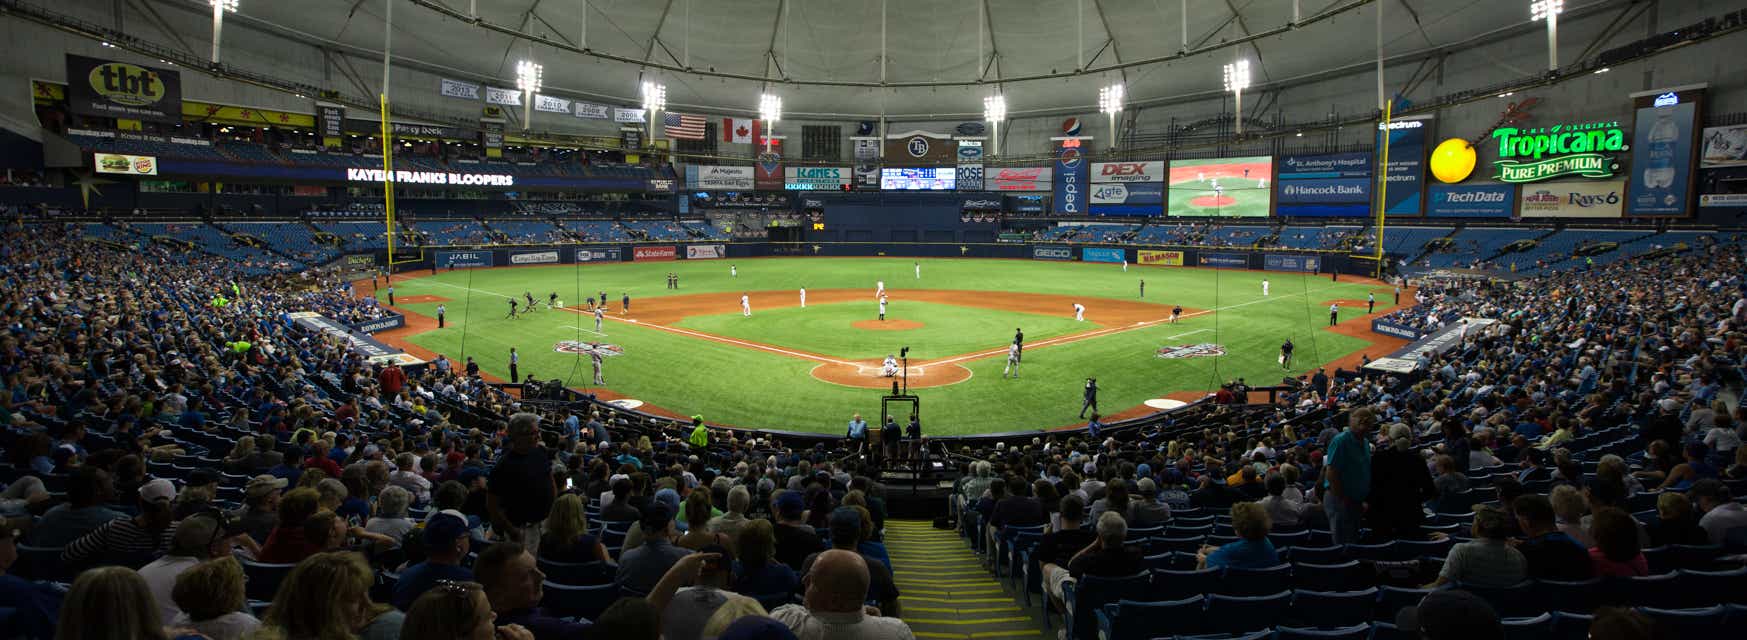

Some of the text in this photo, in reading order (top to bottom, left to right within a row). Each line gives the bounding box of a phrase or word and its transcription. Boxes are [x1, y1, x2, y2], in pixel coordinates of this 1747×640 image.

[1522, 122, 1619, 135] THE ORIGINAL
[912, 140, 926, 154] TB
[1492, 127, 1623, 160] Tropicana
[1101, 163, 1147, 176] DEX
[1305, 159, 1336, 169] Anthony's
[1338, 158, 1366, 167] Hospital
[1502, 158, 1602, 179] PURE PREMIUM
[396, 170, 447, 185] FRANKS
[448, 173, 513, 186] BLOOPERS
[958, 167, 982, 179] ROSE
[1063, 172, 1078, 213] pepsi
[1296, 185, 1364, 195] Hancock Bank
[1606, 191, 1619, 204] 6
[1034, 248, 1071, 258] GEICO
